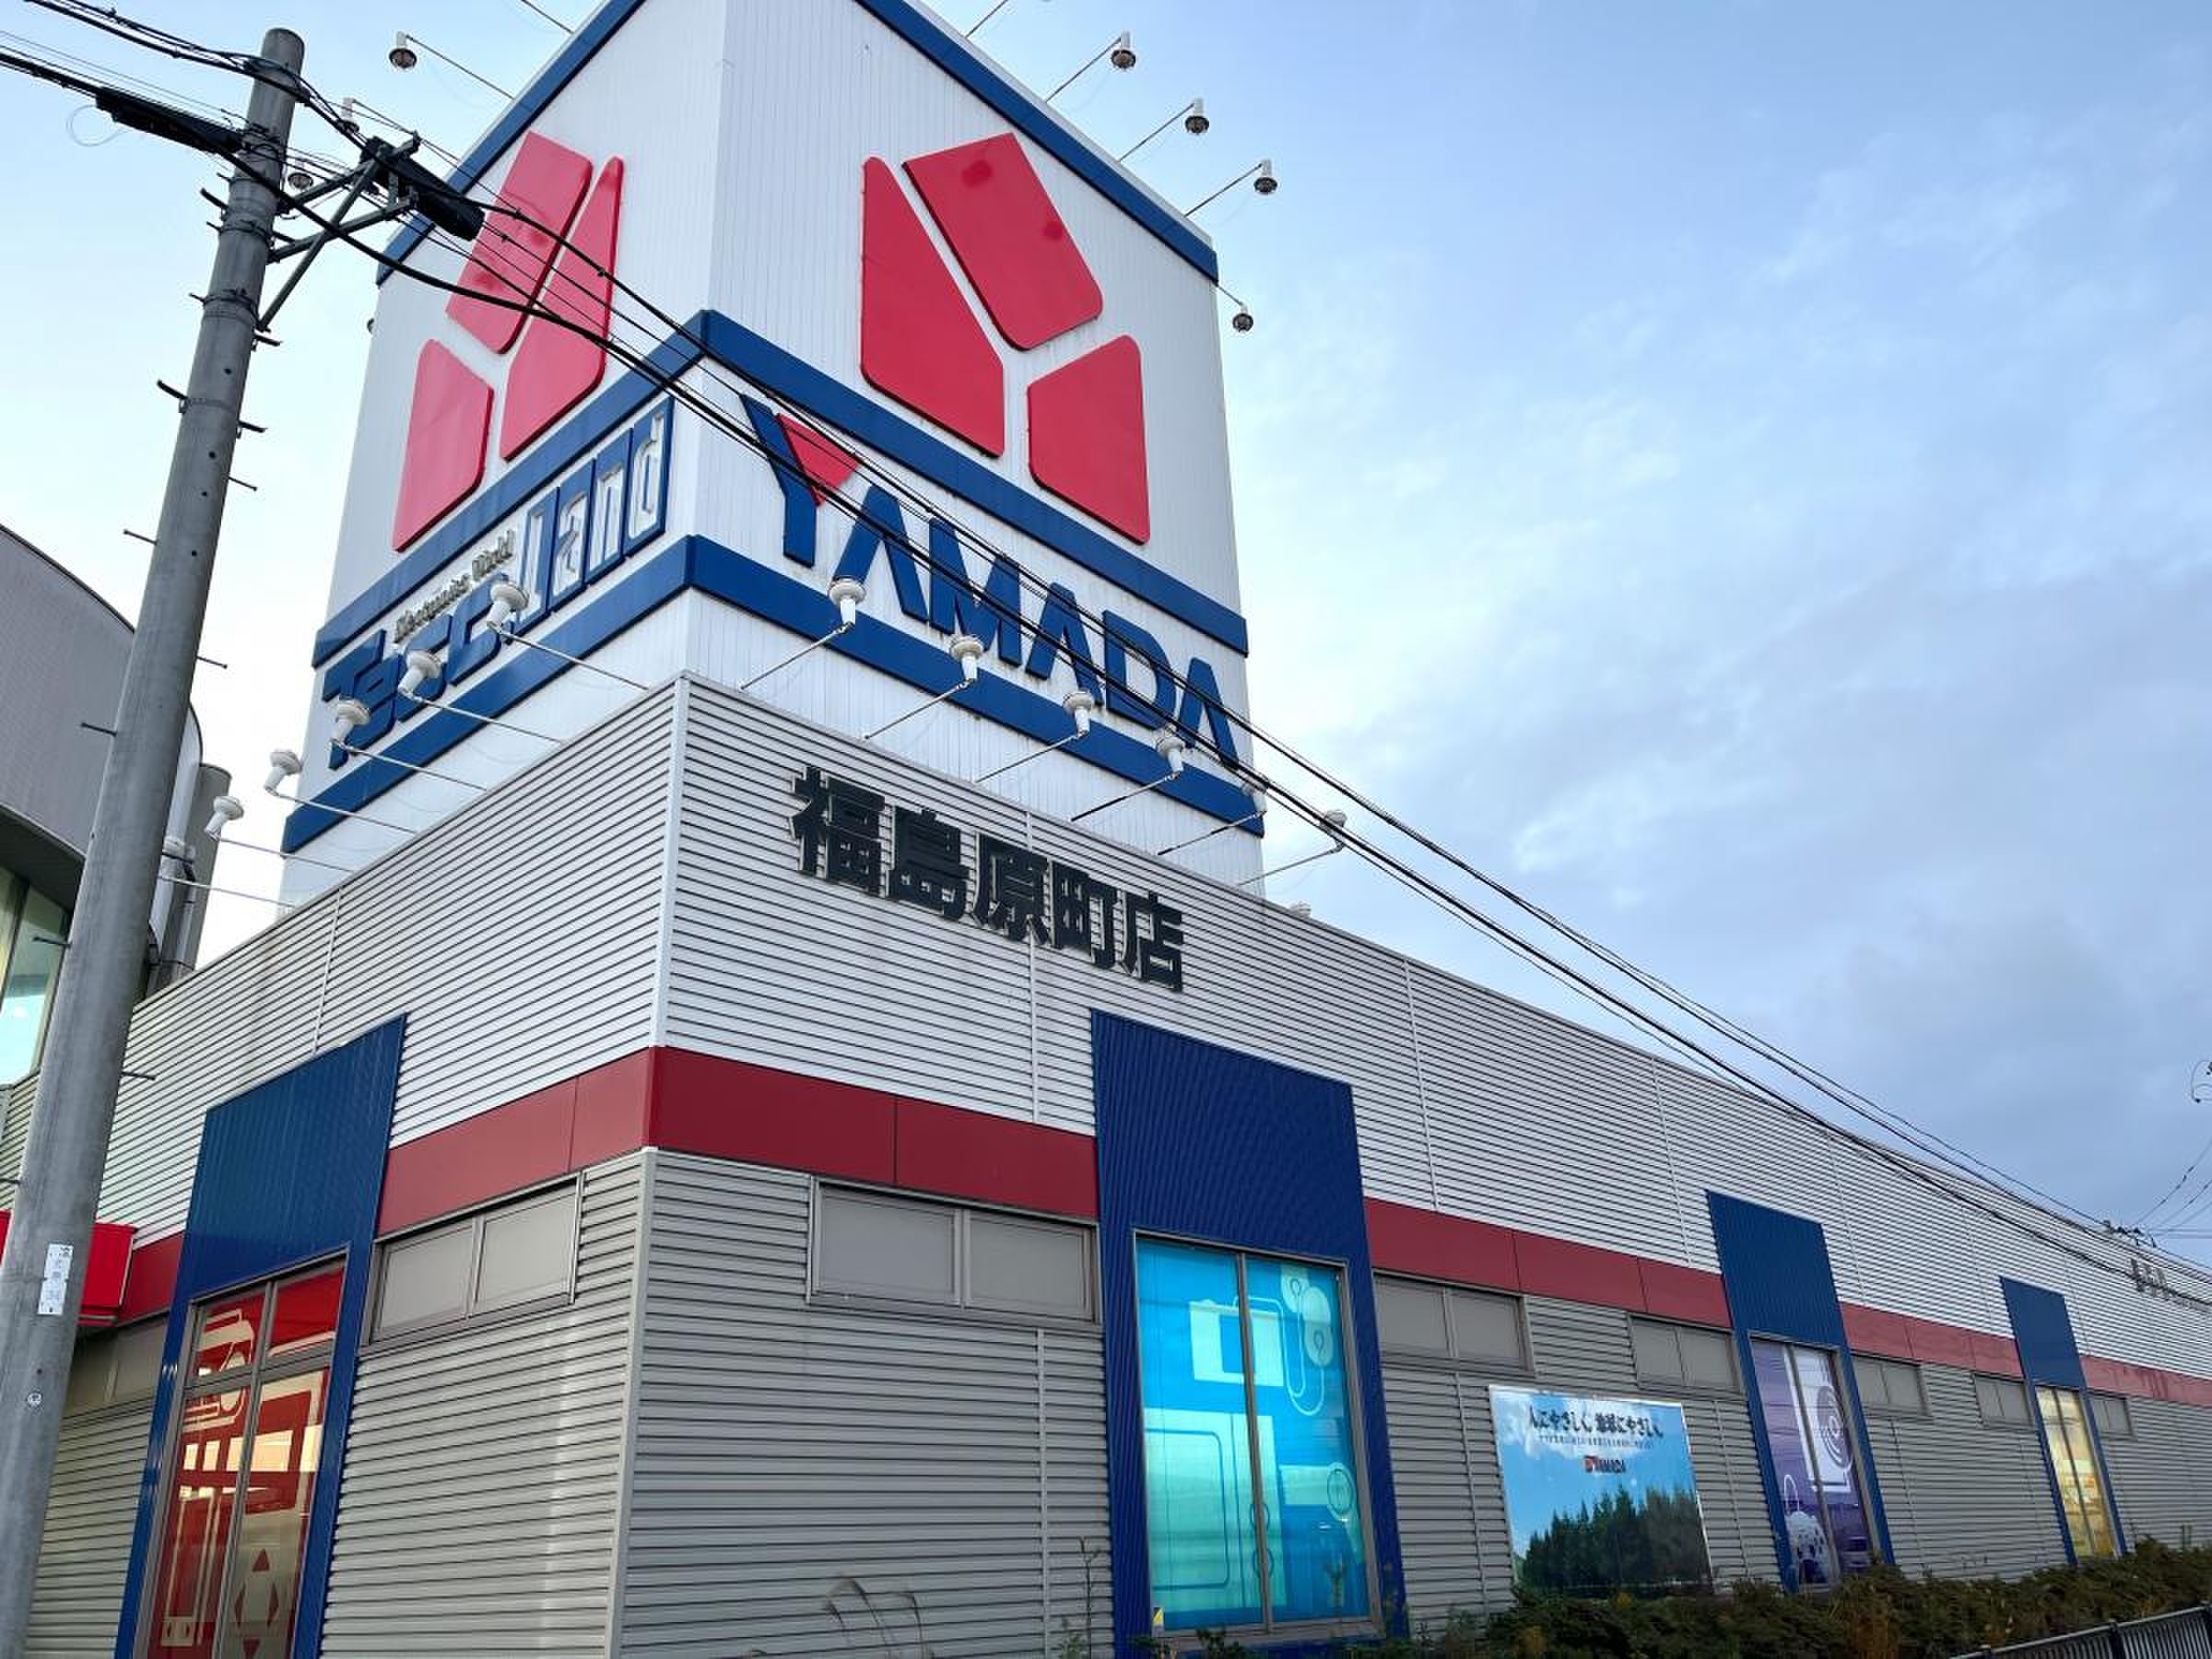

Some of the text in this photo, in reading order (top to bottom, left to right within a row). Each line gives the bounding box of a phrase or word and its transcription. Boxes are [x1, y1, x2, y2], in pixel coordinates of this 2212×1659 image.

[739, 393, 1241, 769] YAMADA
[789, 766, 1184, 993] 福島原町店
